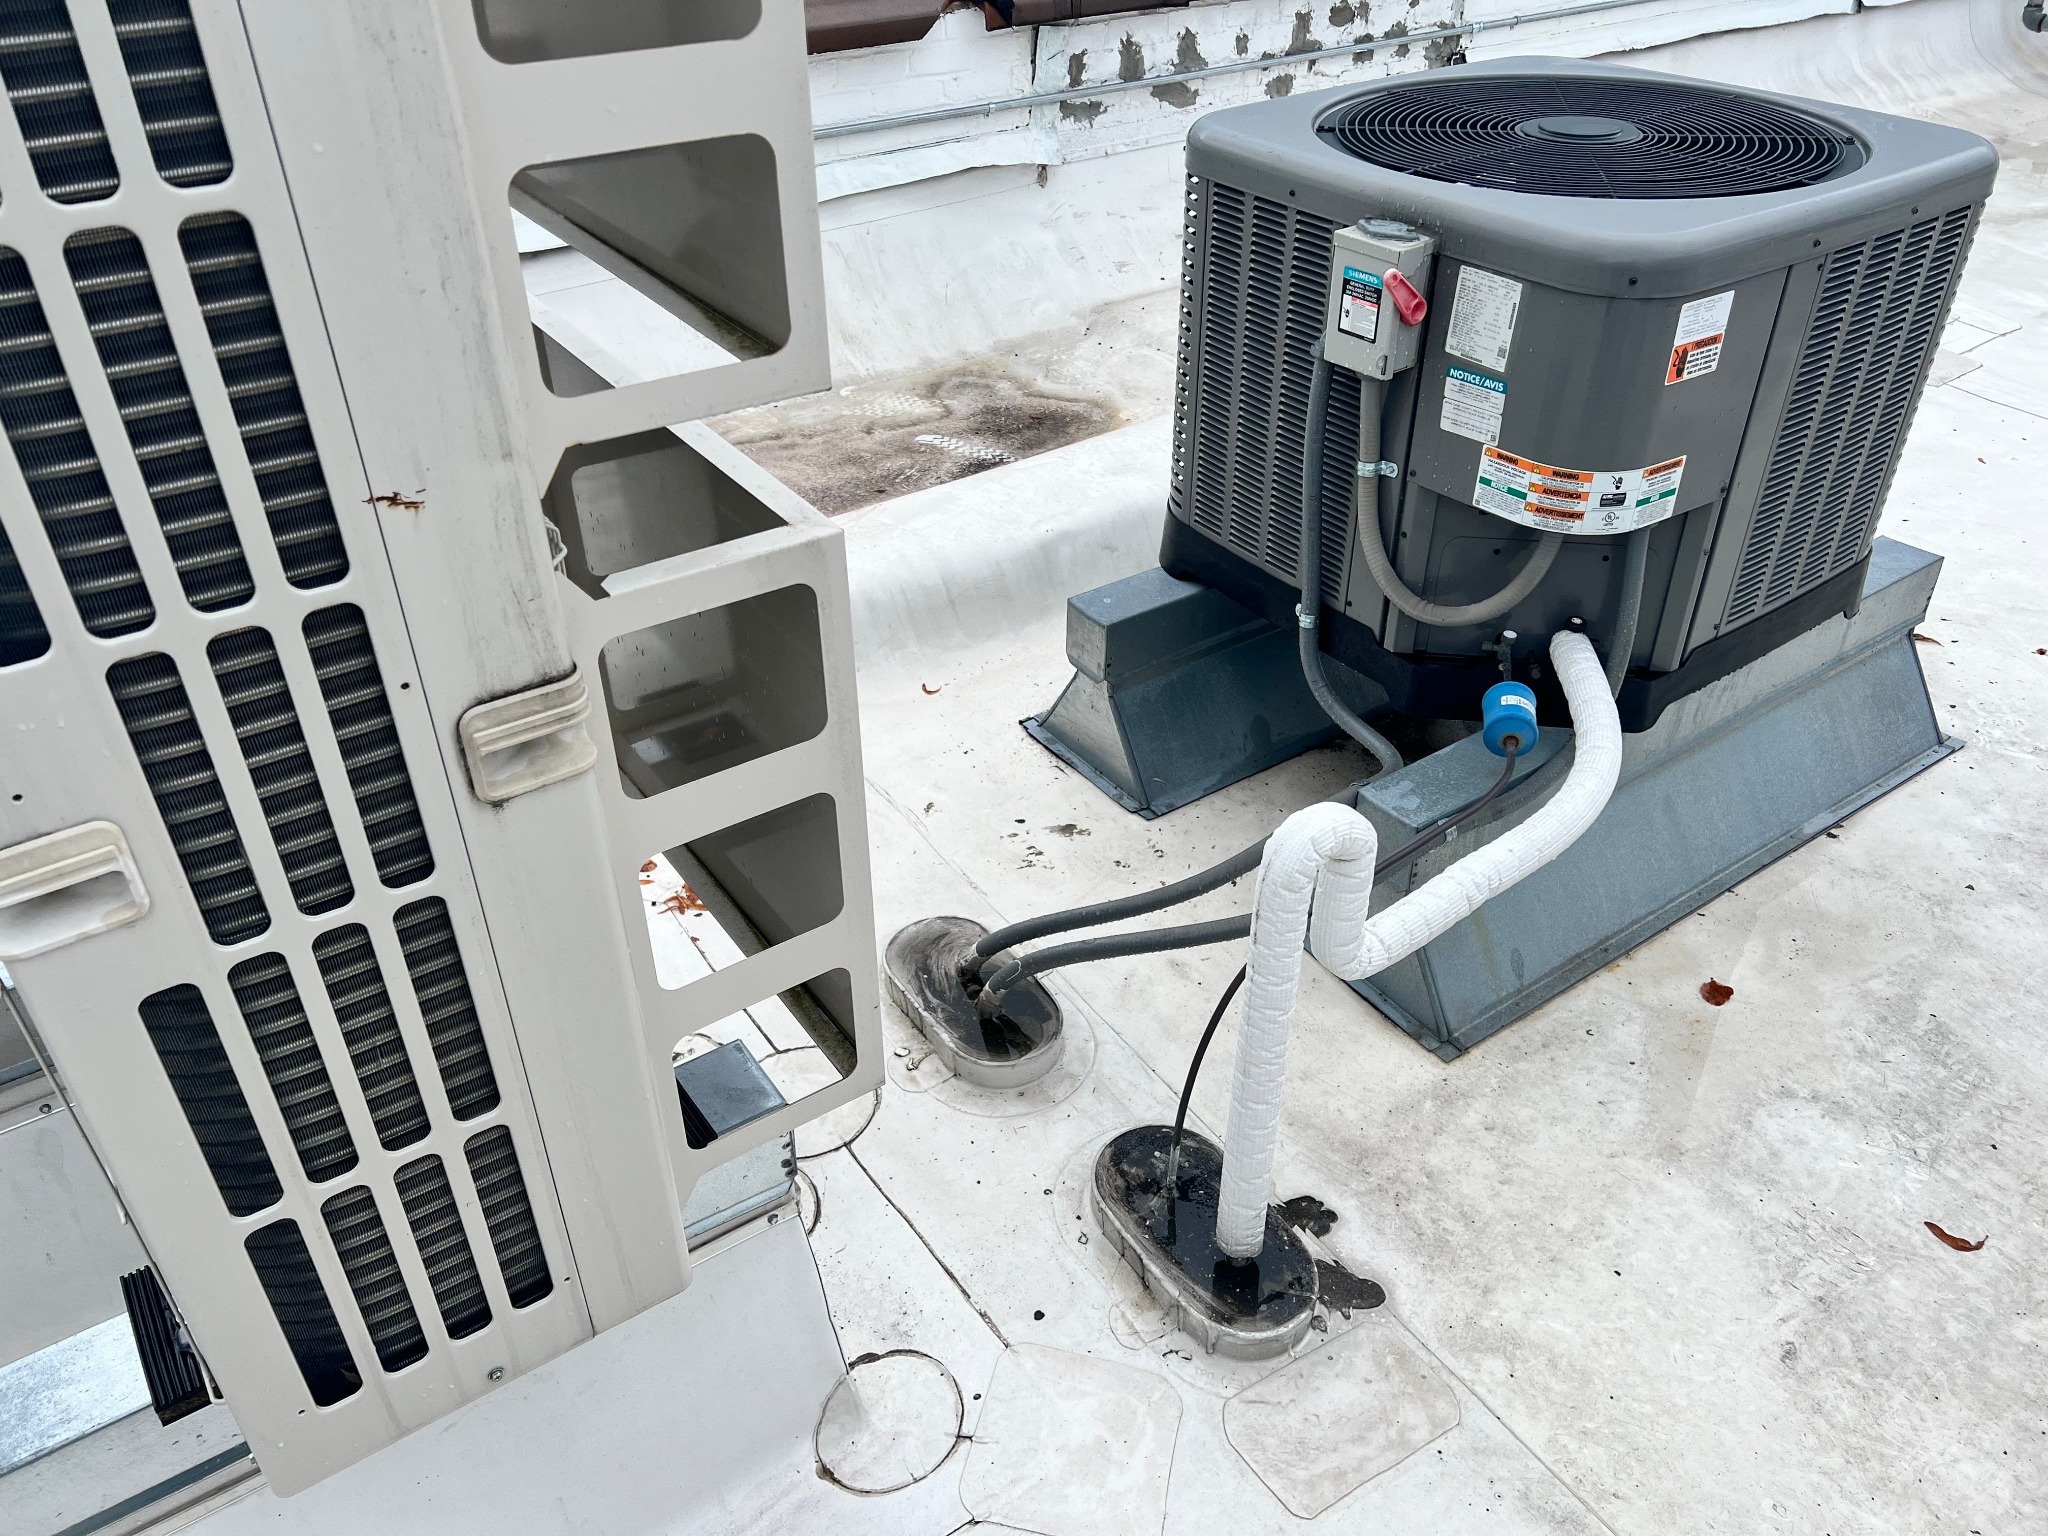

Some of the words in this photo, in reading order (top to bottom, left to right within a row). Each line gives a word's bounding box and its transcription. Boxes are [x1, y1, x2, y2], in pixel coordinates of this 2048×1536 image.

[1348, 269, 1378, 284] SIEMENS
[1449, 368, 1504, 392] NOTICE/AVIS
[1497, 452, 1519, 466] WARNING
[1552, 470, 1580, 480] WARNING
[1490, 480, 1509, 493] NOTICE
[1542, 488, 1582, 500] ADVERTENCIA
[1535, 506, 1584, 520] ADVERTISSEMENT
